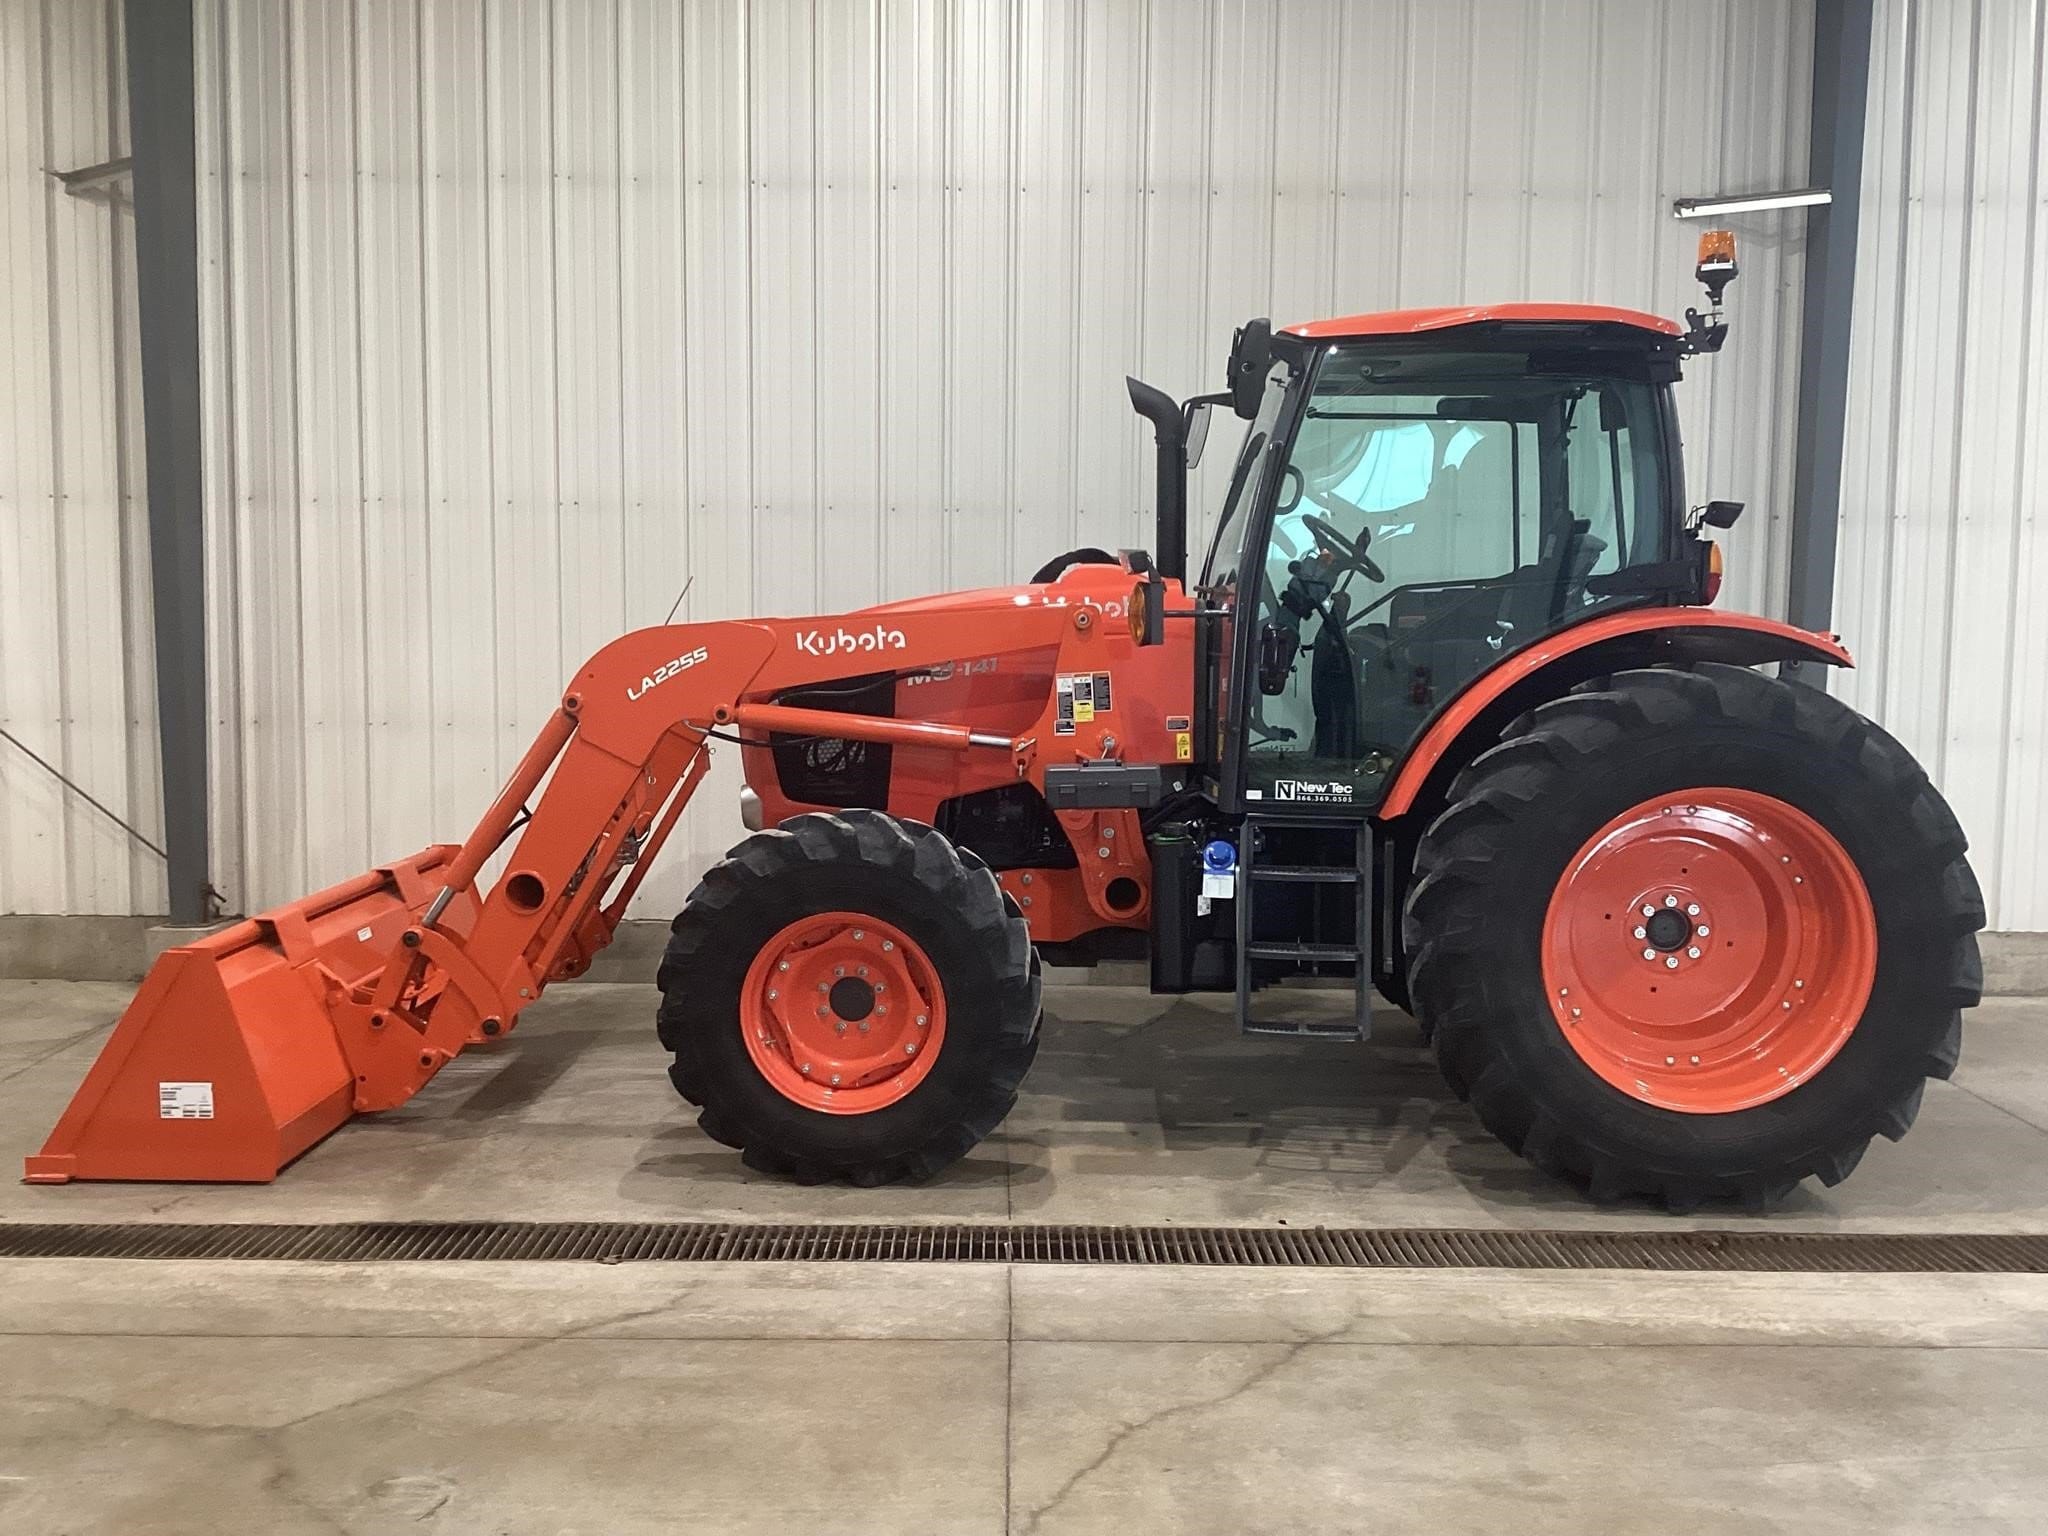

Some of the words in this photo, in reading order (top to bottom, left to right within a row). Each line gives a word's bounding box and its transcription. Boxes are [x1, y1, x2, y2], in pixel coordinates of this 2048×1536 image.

[796, 624, 907, 656] Kubota
[627, 646, 709, 702] LA2255
[1297, 781, 1328, 793] New
[1329, 782, 1353, 794] Tec
[1297, 795, 1352, 803] 866.369.0505
